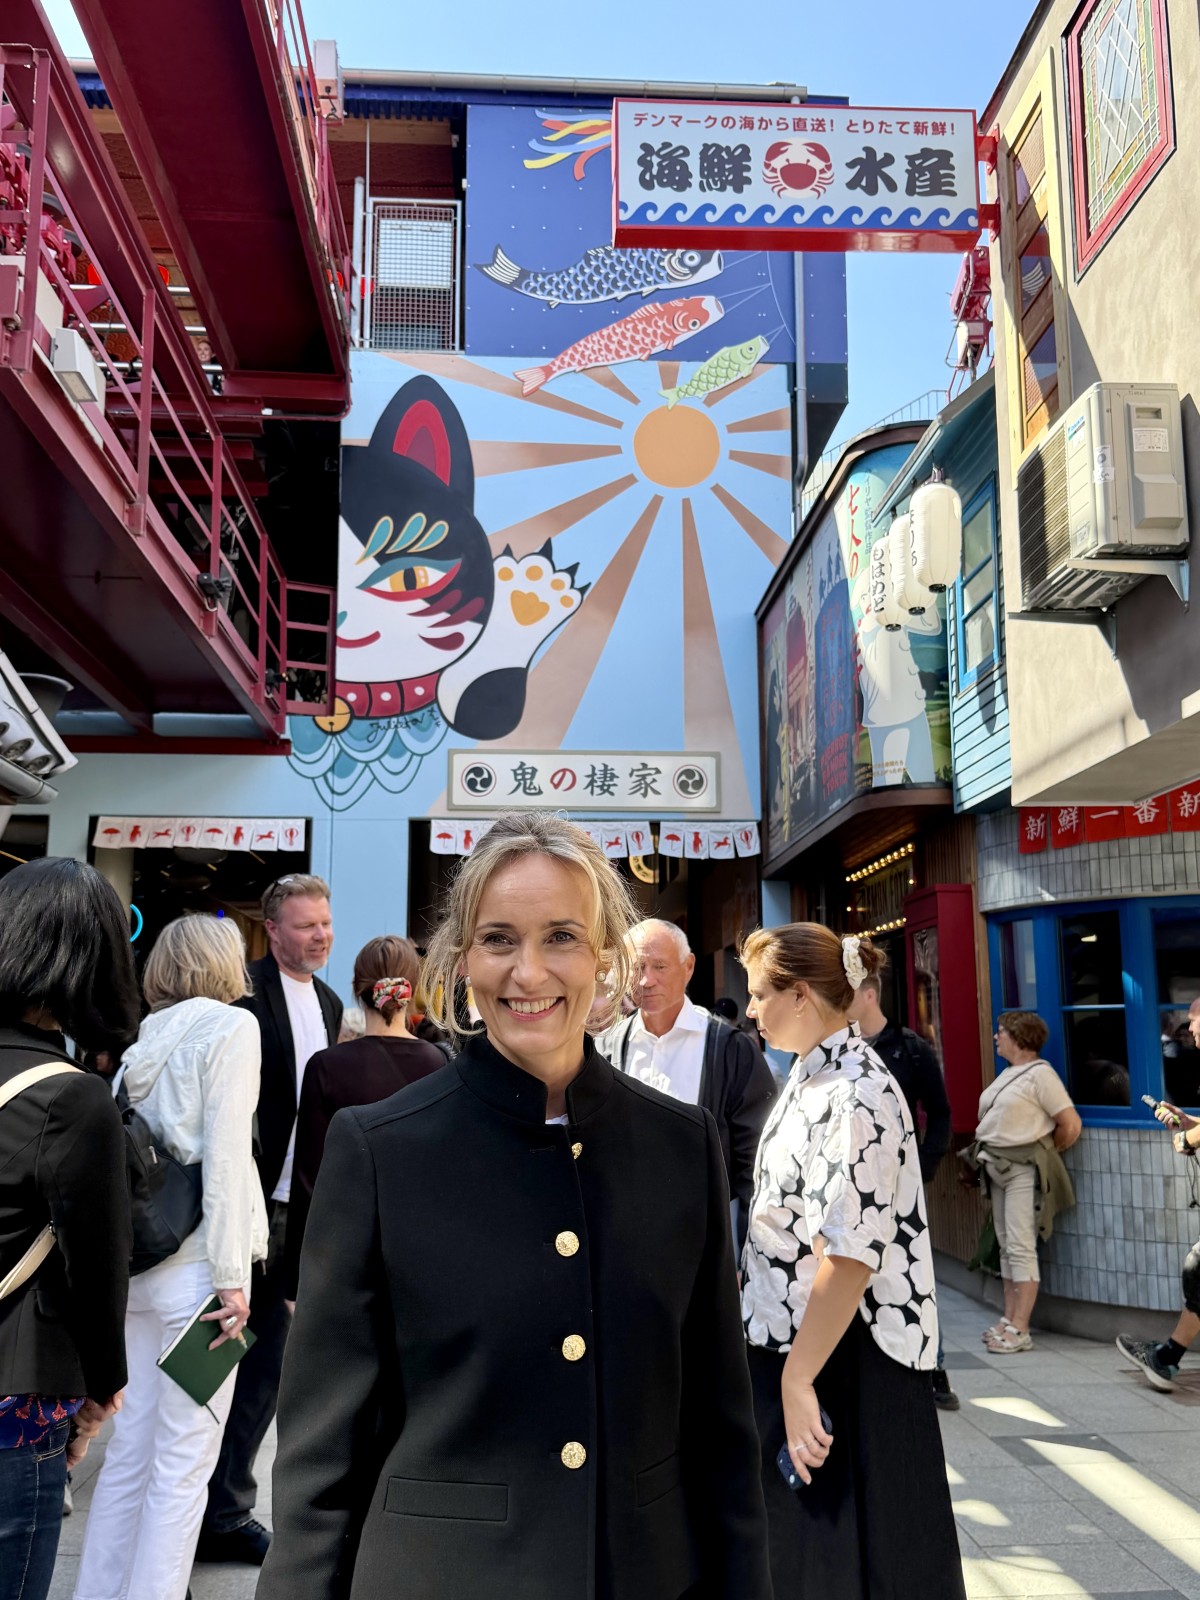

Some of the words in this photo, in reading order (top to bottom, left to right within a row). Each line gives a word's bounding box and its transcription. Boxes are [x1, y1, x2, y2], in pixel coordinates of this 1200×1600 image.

[872, 548, 887, 613] もはめど
[507, 761, 662, 799] 鬼の棲家
